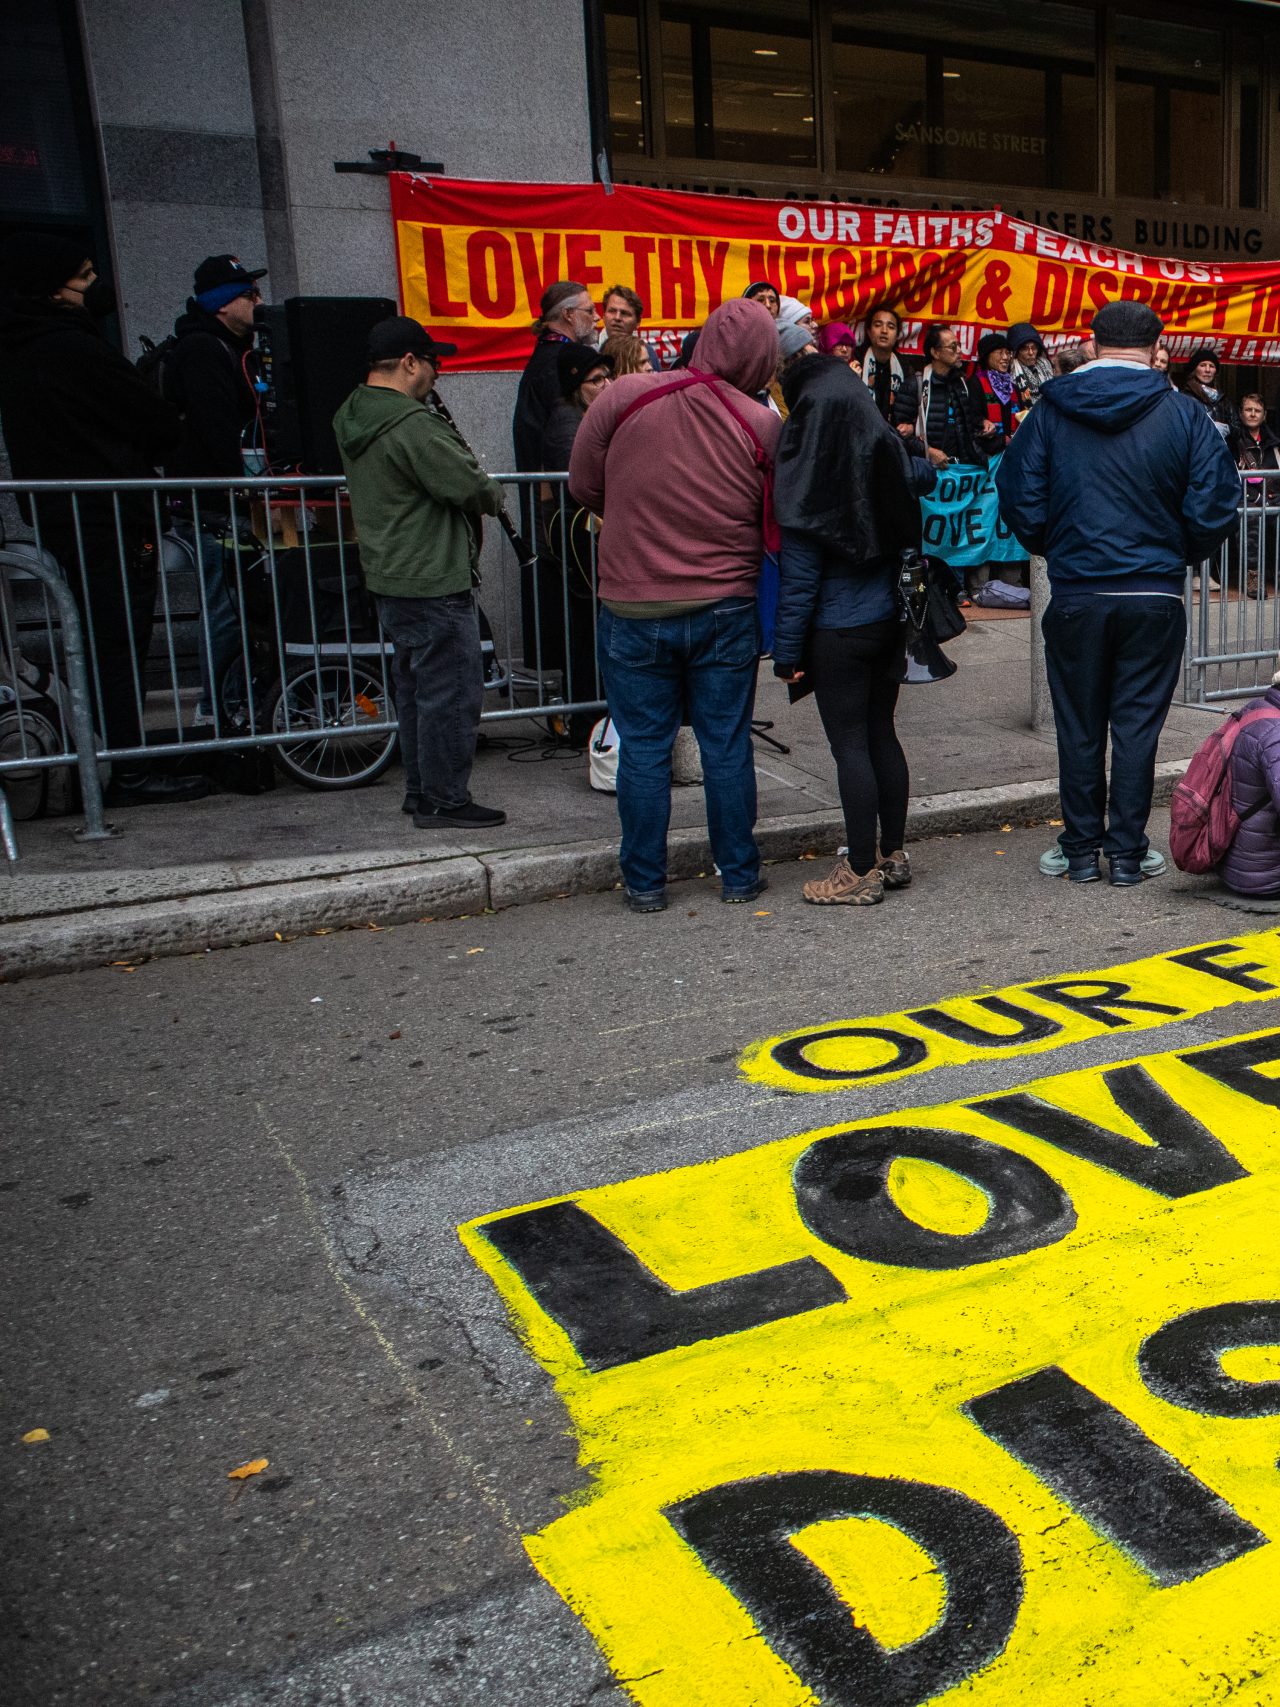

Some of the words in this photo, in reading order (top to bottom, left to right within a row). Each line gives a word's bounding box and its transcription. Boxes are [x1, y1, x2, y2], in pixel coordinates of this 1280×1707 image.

[895, 122, 986, 149] SANSOME
[993, 133, 1047, 154] STREET
[778, 206, 861, 242] OUR
[1008, 220, 1144, 275] TEACH
[1159, 261, 1224, 283] US:
[1135, 219, 1263, 253] BUILDING
[422, 227, 603, 319] LOVE
[624, 235, 730, 320] THY
[748, 244, 968, 320] NEIGHBOR
[976, 259, 1012, 322] &
[1229, 339, 1258, 361] LA
[770, 979, 1187, 1080] OUR
